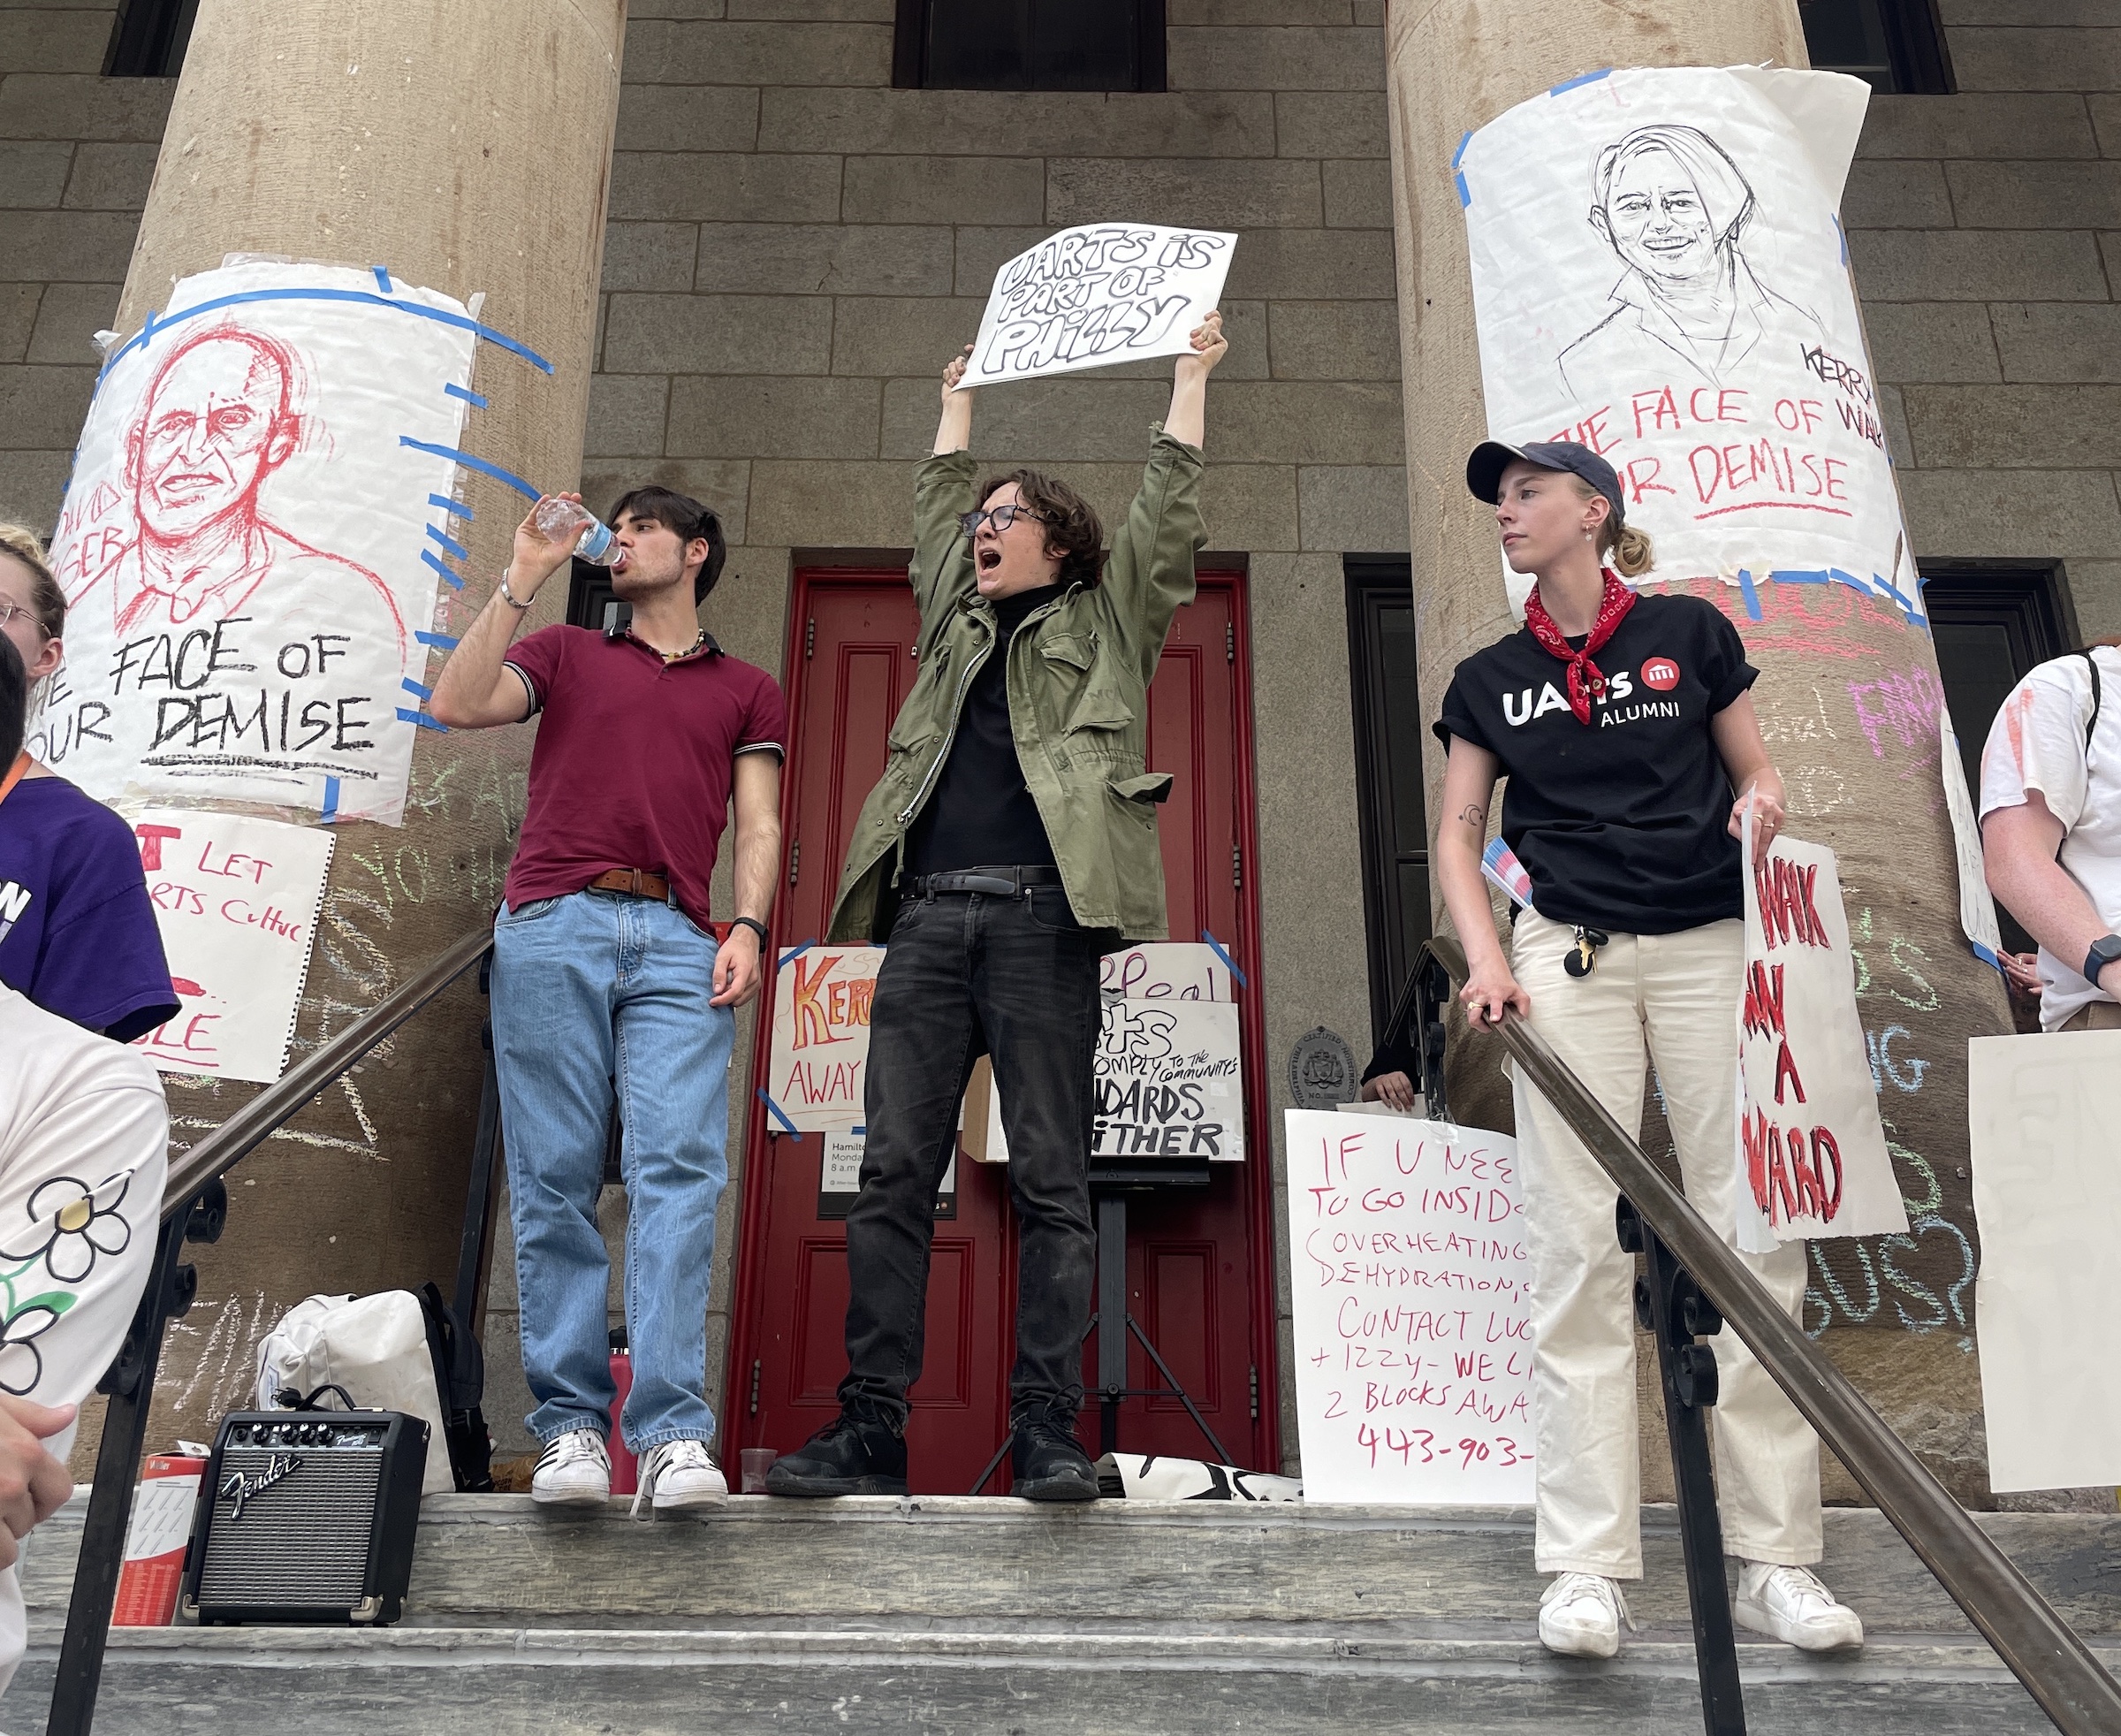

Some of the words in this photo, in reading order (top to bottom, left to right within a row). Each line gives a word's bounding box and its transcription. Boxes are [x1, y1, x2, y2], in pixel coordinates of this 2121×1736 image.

[1001, 229, 1154, 294] UARTS
[998, 272, 1111, 323] PART
[1108, 267, 1166, 298] OF
[1632, 385, 1748, 439] FACE
[1775, 399, 1824, 435] OF
[1689, 438, 1849, 504] DEMISE
[110, 616, 258, 696] FACE
[277, 633, 351, 679] OF
[149, 689, 375, 752] DEMISE
[1600, 701, 1680, 728] ALUMNI
[198, 841, 273, 884] LET
[150, 882, 208, 915] RTS
[131, 1013, 223, 1052] LE
[782, 1060, 861, 1105] AWAY
[1093, 1053, 1162, 1085] OMPLY
[1169, 1055, 1183, 1069] TO
[831, 1163, 838, 1172] 8
[832, 1153, 863, 1161] Monda
[1322, 1131, 1366, 1187] IF
[1396, 1138, 1424, 1175] U
[1446, 1144, 1512, 1184] NEE
[1308, 1187, 1349, 1218] TO
[1363, 1188, 1404, 1212] GO
[1486, 1312, 1531, 1342] LUC
[1455, 1350, 1495, 1382] WE
[1325, 1391, 1348, 1419] 2
[1455, 1389, 1530, 1423] AWA
[1358, 1423, 1535, 1470] 443-903-
[222, 1453, 300, 1519] Fender
